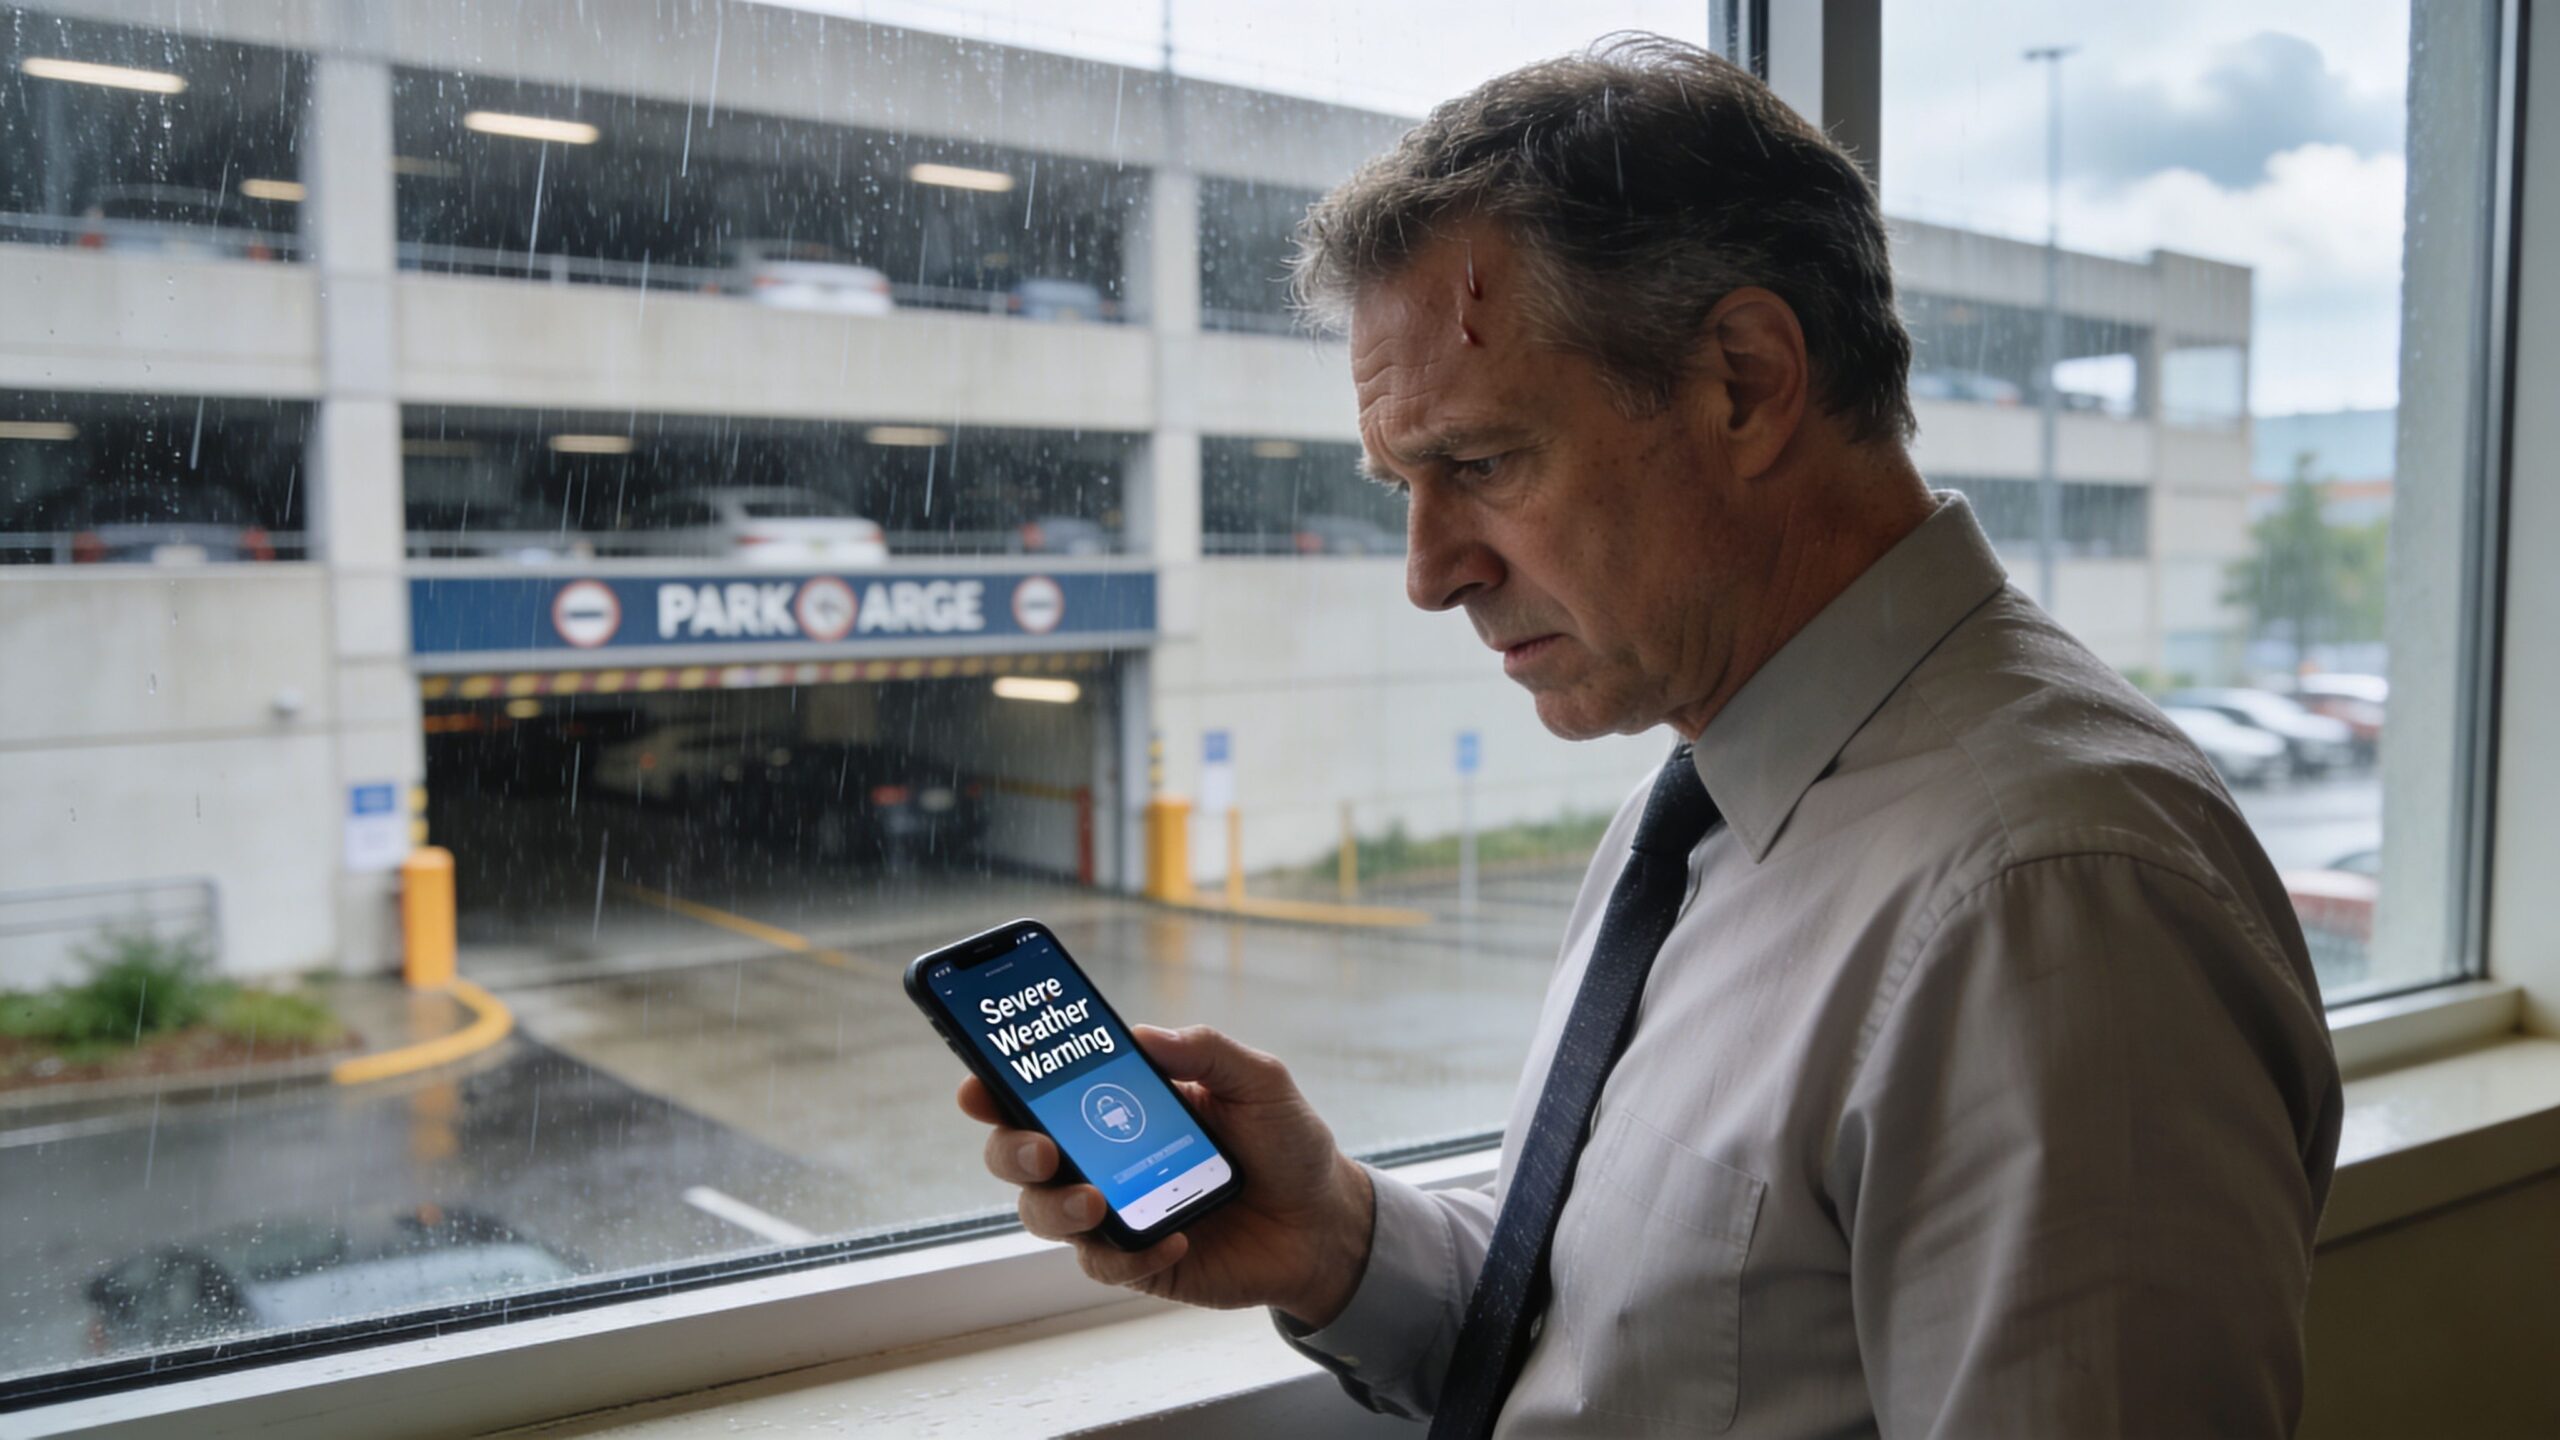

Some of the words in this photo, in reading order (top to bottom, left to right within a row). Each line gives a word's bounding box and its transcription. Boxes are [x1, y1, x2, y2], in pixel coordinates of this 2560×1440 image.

[657, 582, 798, 639] PARK
[857, 580, 986, 633] ARGE
[979, 977, 1063, 1025] Severe
[986, 997, 1090, 1057] Weather
[1010, 1025, 1115, 1084] Warning
